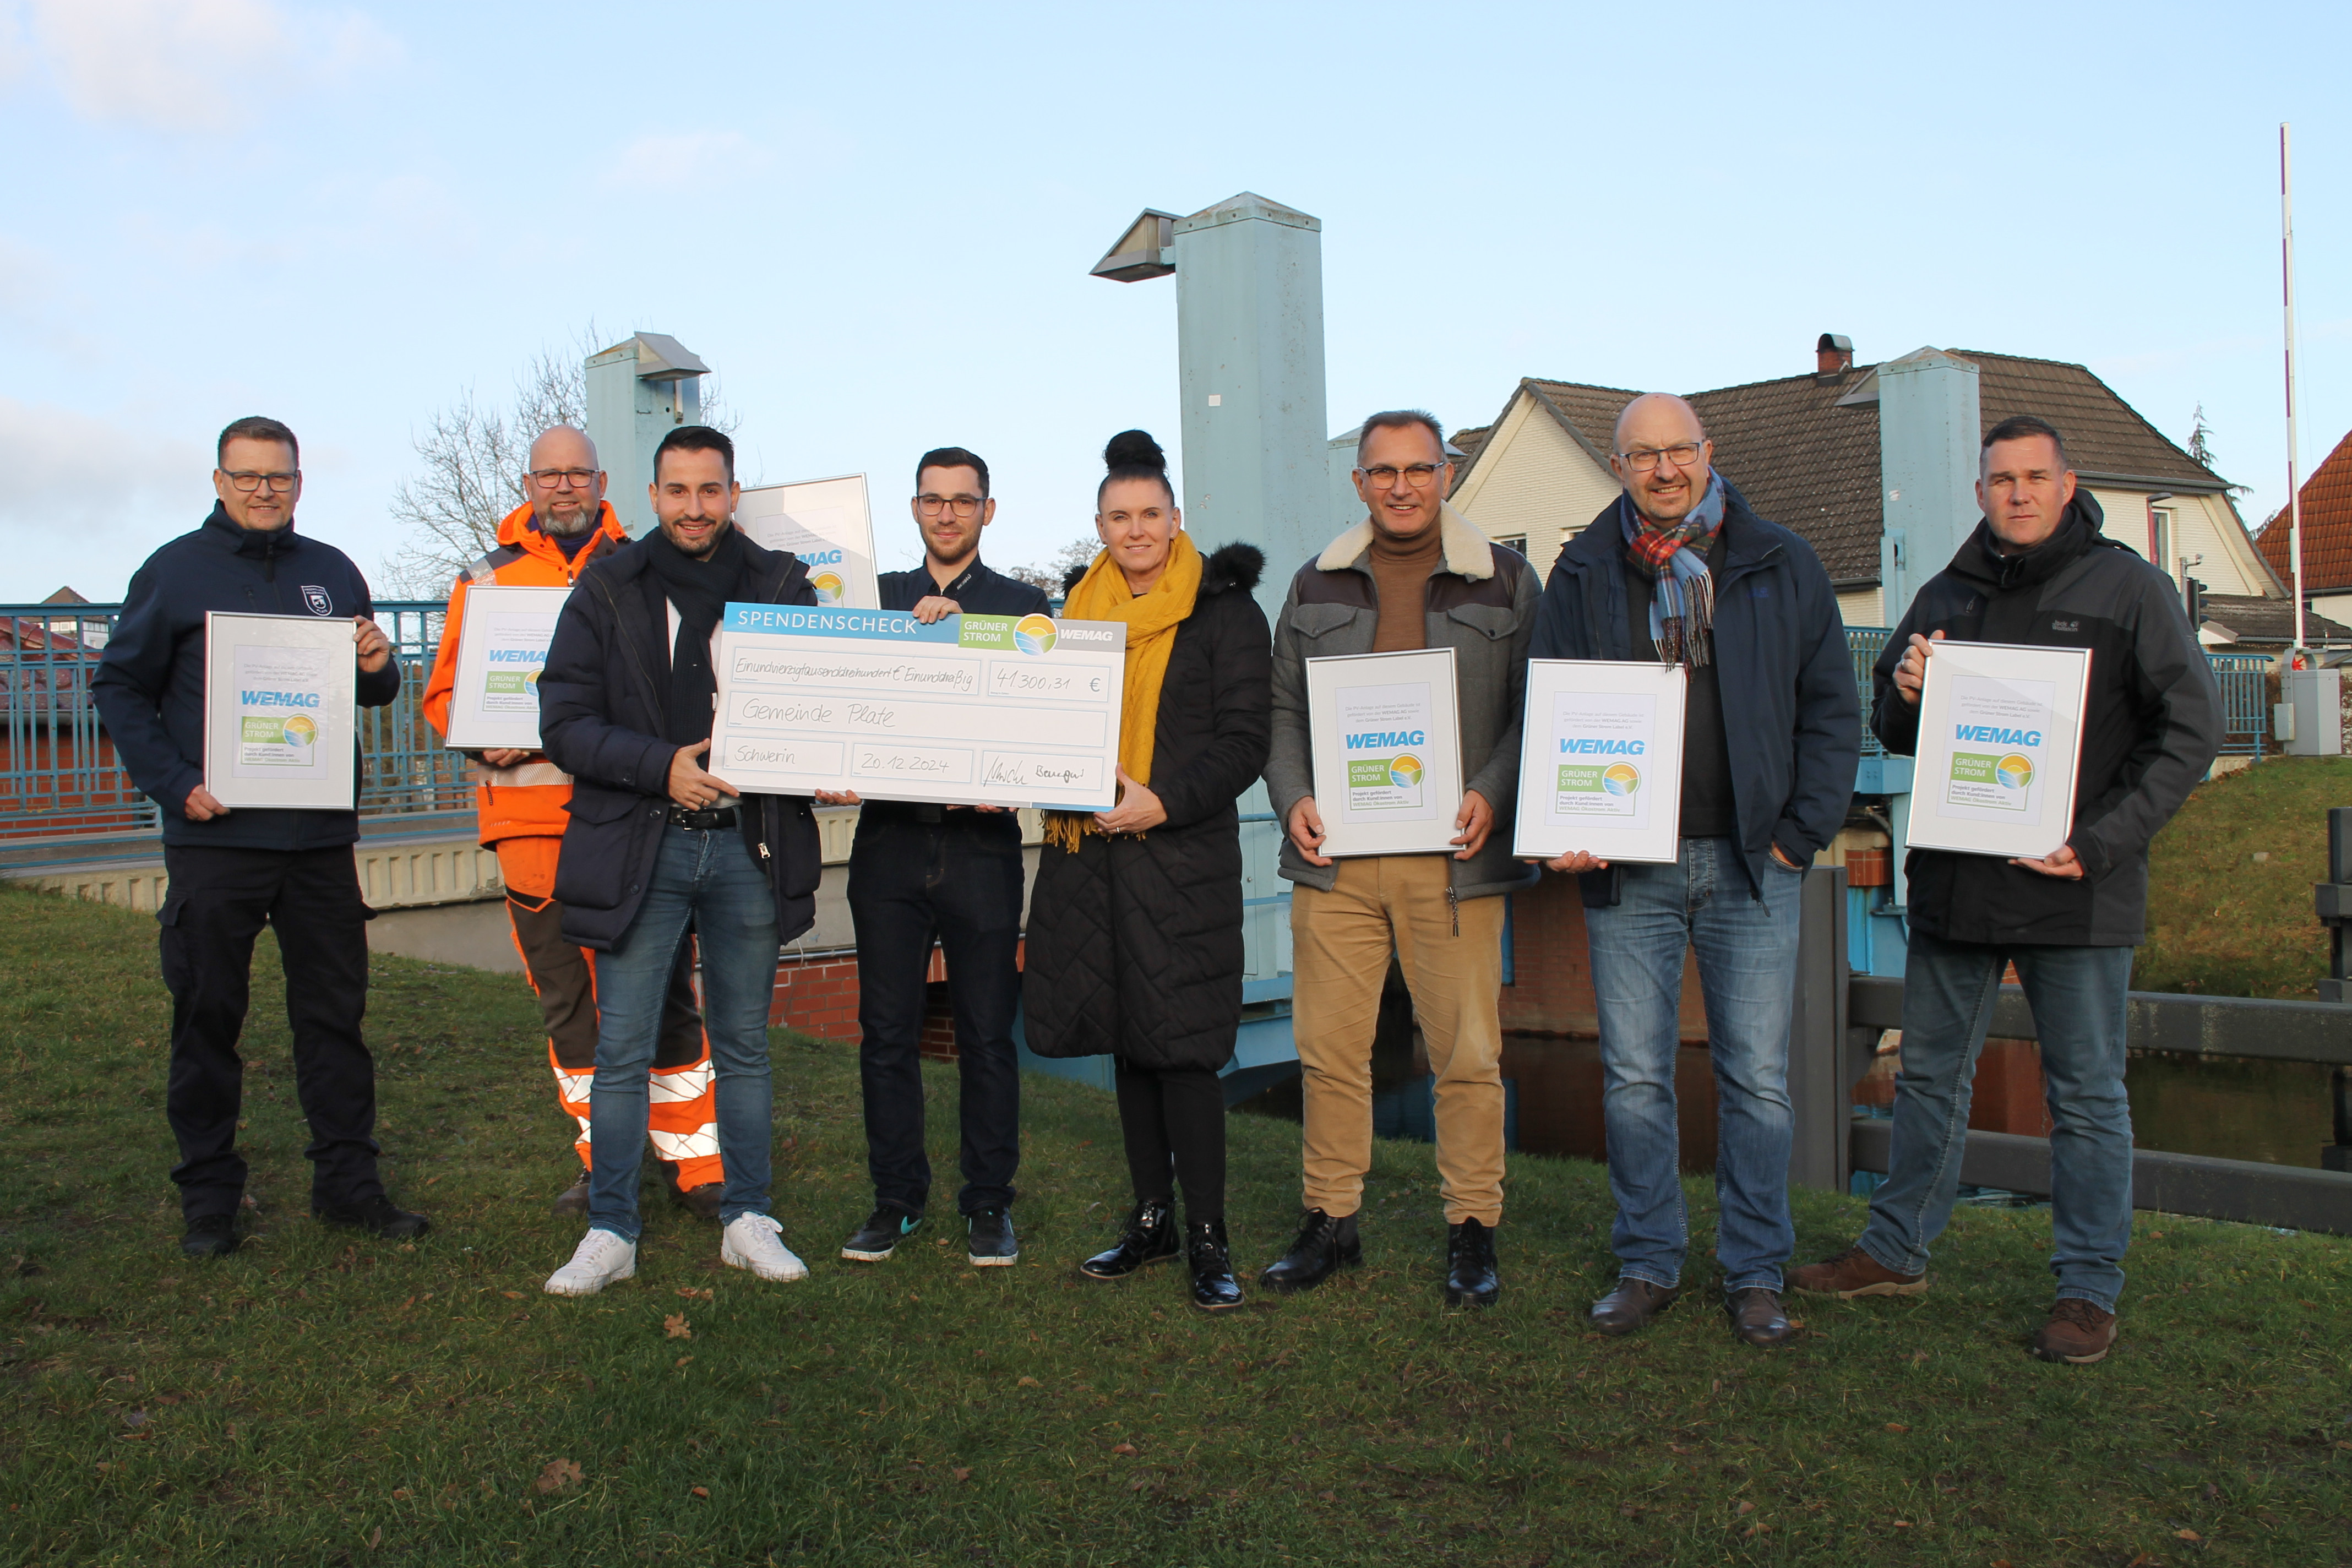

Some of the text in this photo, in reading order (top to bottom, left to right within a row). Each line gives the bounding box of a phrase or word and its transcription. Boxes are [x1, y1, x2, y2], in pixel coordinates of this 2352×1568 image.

[794, 549, 842, 567] MAG
[738, 611, 917, 634] SPENDENSCHECK
[965, 620, 1008, 631] GRÜNER
[963, 632, 1001, 642] STROM
[1060, 629, 1113, 641] WEMAG
[489, 650, 546, 662] WEMA
[1089, 678, 1101, 692] €
[242, 690, 321, 707] WEMAG
[743, 698, 895, 727] Gemeinde Plate
[244, 721, 278, 730] GRÜNER
[1346, 730, 1425, 749] WEMAG
[1954, 724, 2042, 747] WEMAG
[1559, 738, 1646, 755] WEMAG
[734, 745, 795, 764] Schwerin
[1351, 764, 1384, 774] GRÜNER
[1955, 757, 1992, 769] GRÜNER
[1352, 774, 1380, 782] STROM
[1561, 769, 1598, 778] GRÜNER
[1954, 767, 1985, 777] STROM
